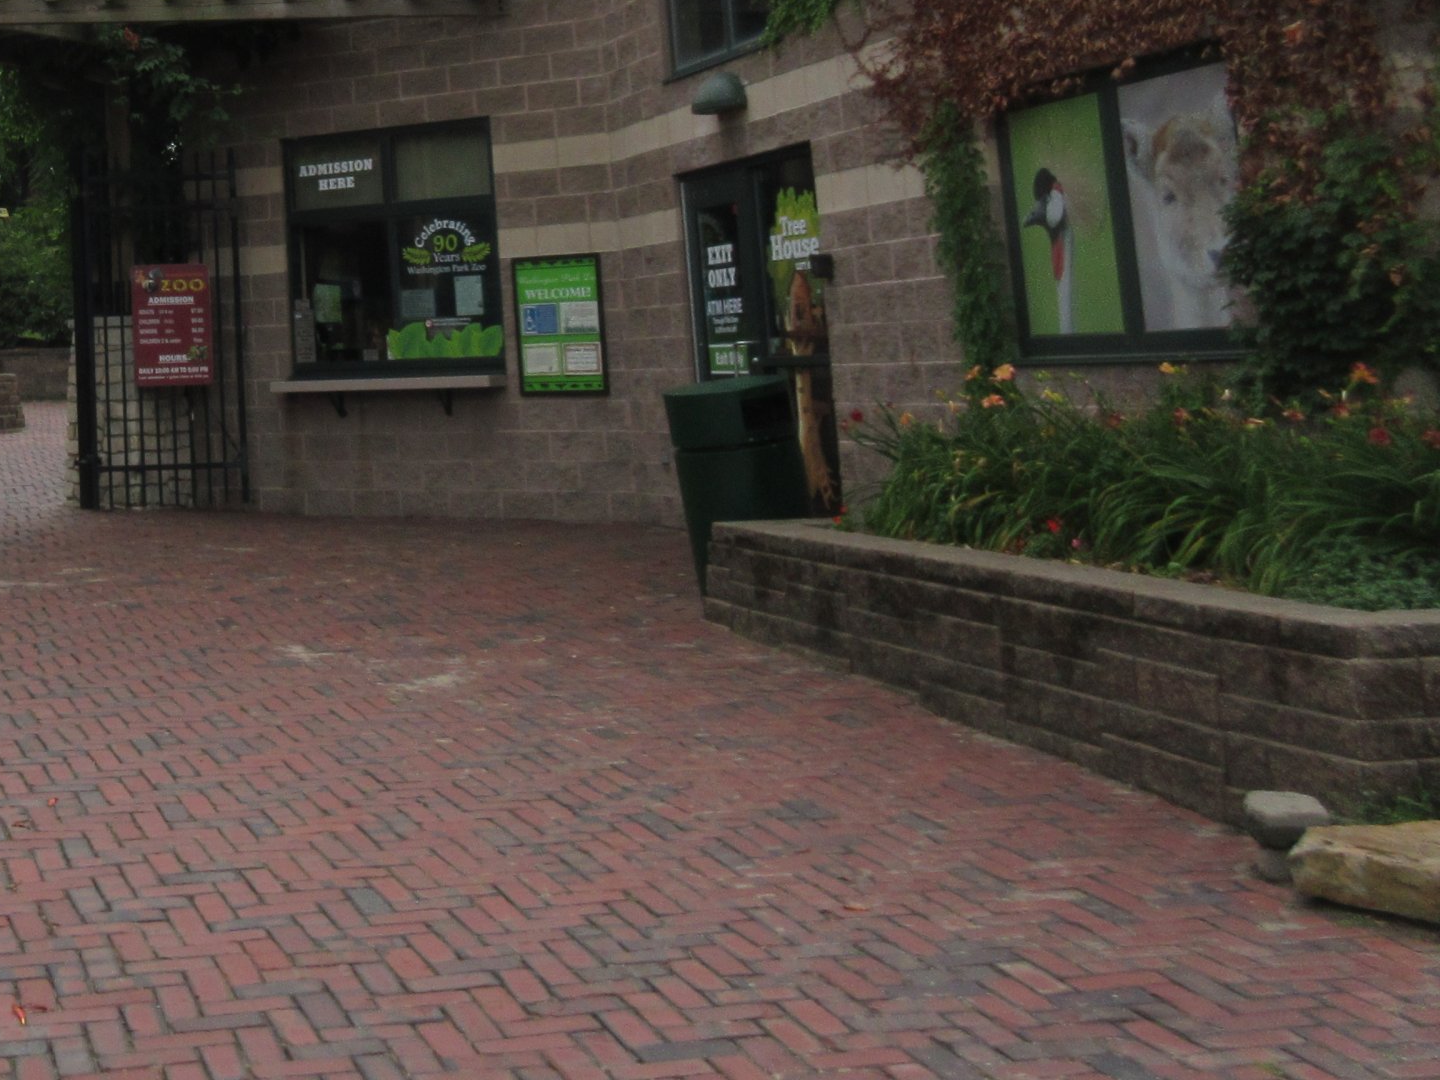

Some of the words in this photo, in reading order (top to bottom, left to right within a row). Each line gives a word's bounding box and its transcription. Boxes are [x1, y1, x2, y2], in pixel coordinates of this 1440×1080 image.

[299, 158, 373, 177] ADMISSION
[318, 176, 355, 191] HERE
[414, 219, 476, 248] Celebrating
[779, 216, 807, 236] Tree
[432, 234, 457, 252] 90
[769, 235, 820, 261] House
[432, 253, 460, 263] Years
[707, 244, 733, 265] EXIT
[452, 264, 469, 272] Park
[471, 263, 486, 271] Zoo
[160, 279, 205, 292] ZOO
[707, 267, 736, 288] ONLY
[148, 296, 194, 305] ADMISSION
[159, 354, 189, 362] HOURS
